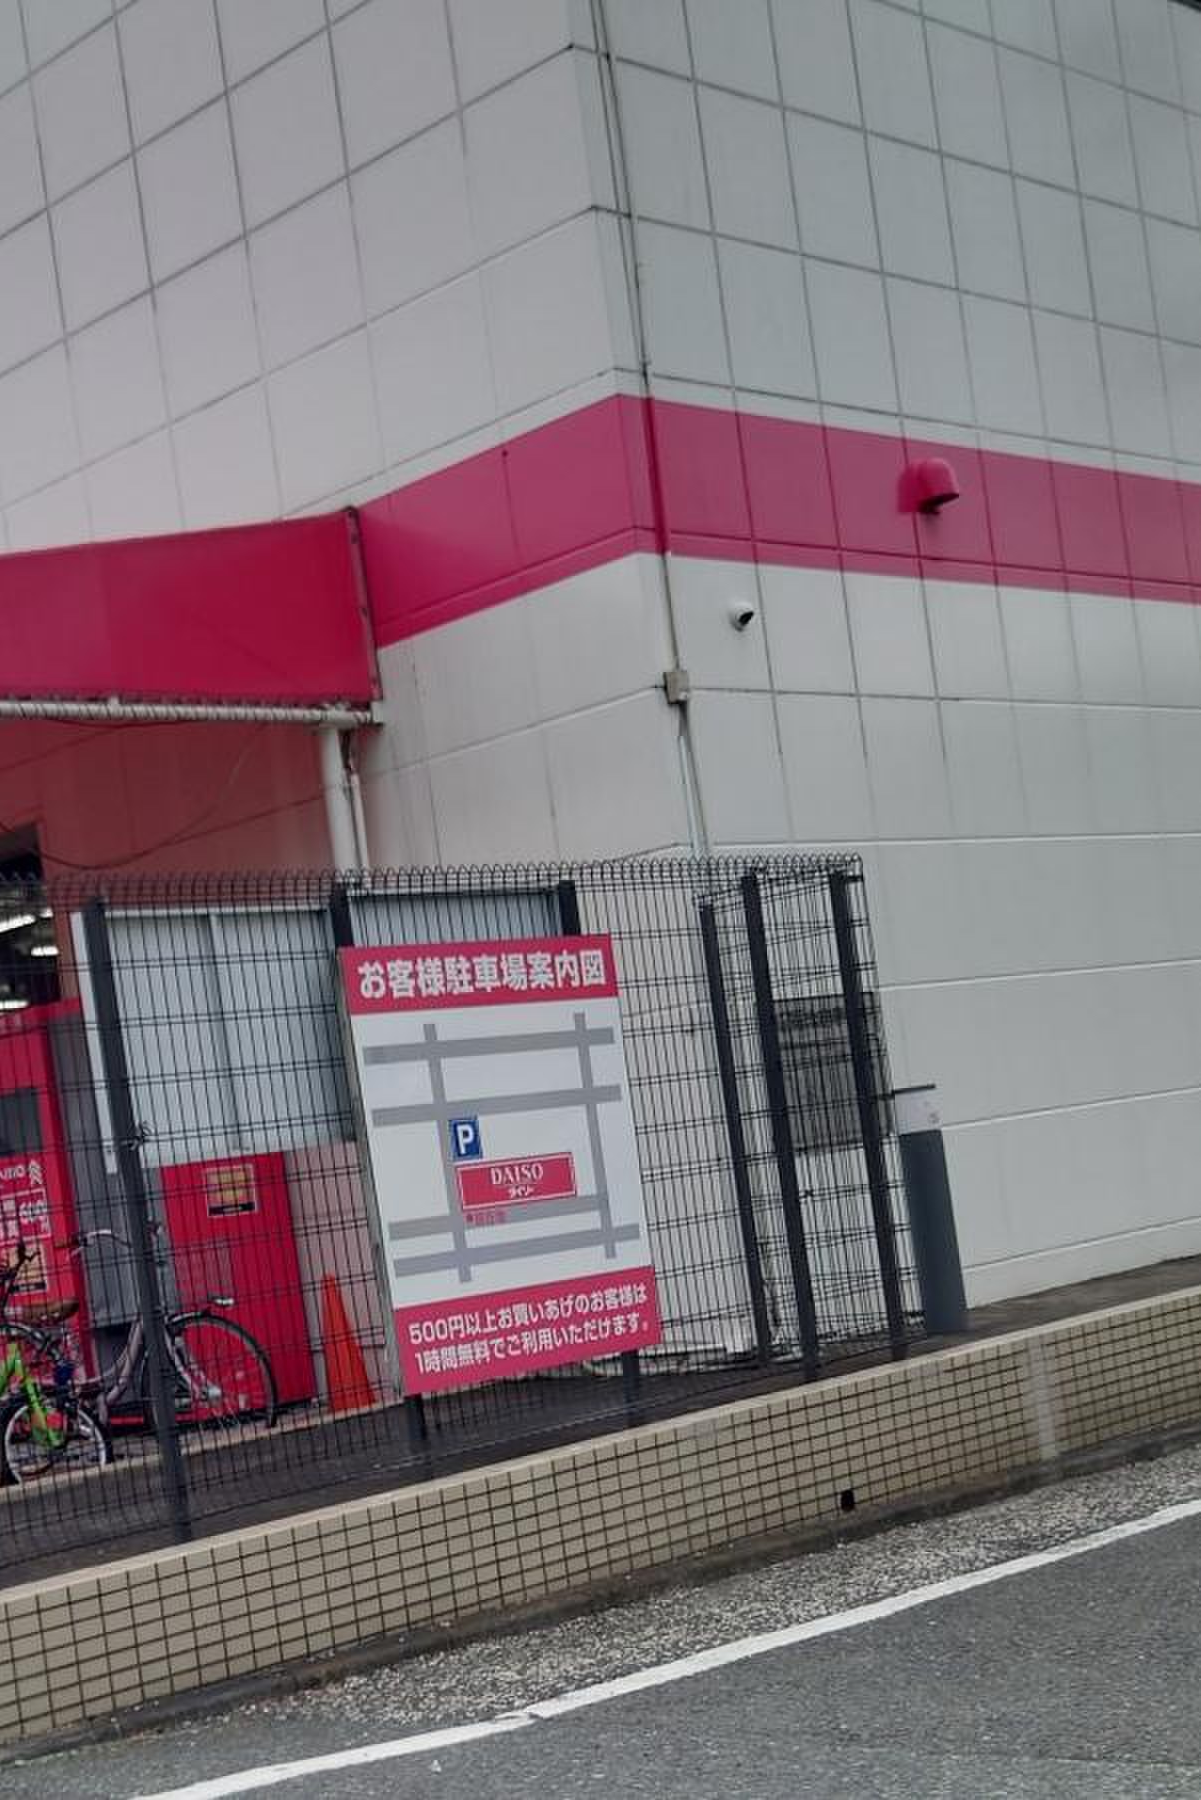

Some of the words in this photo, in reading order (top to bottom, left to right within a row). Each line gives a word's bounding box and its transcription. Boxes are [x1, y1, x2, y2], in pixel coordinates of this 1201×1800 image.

[357, 949, 607, 999] お客様駐車場案内図
[456, 1123, 475, 1155] P
[490, 1162, 544, 1185] DAISO
[408, 1282, 648, 1345] 500円以上お買いあげのお客様は
